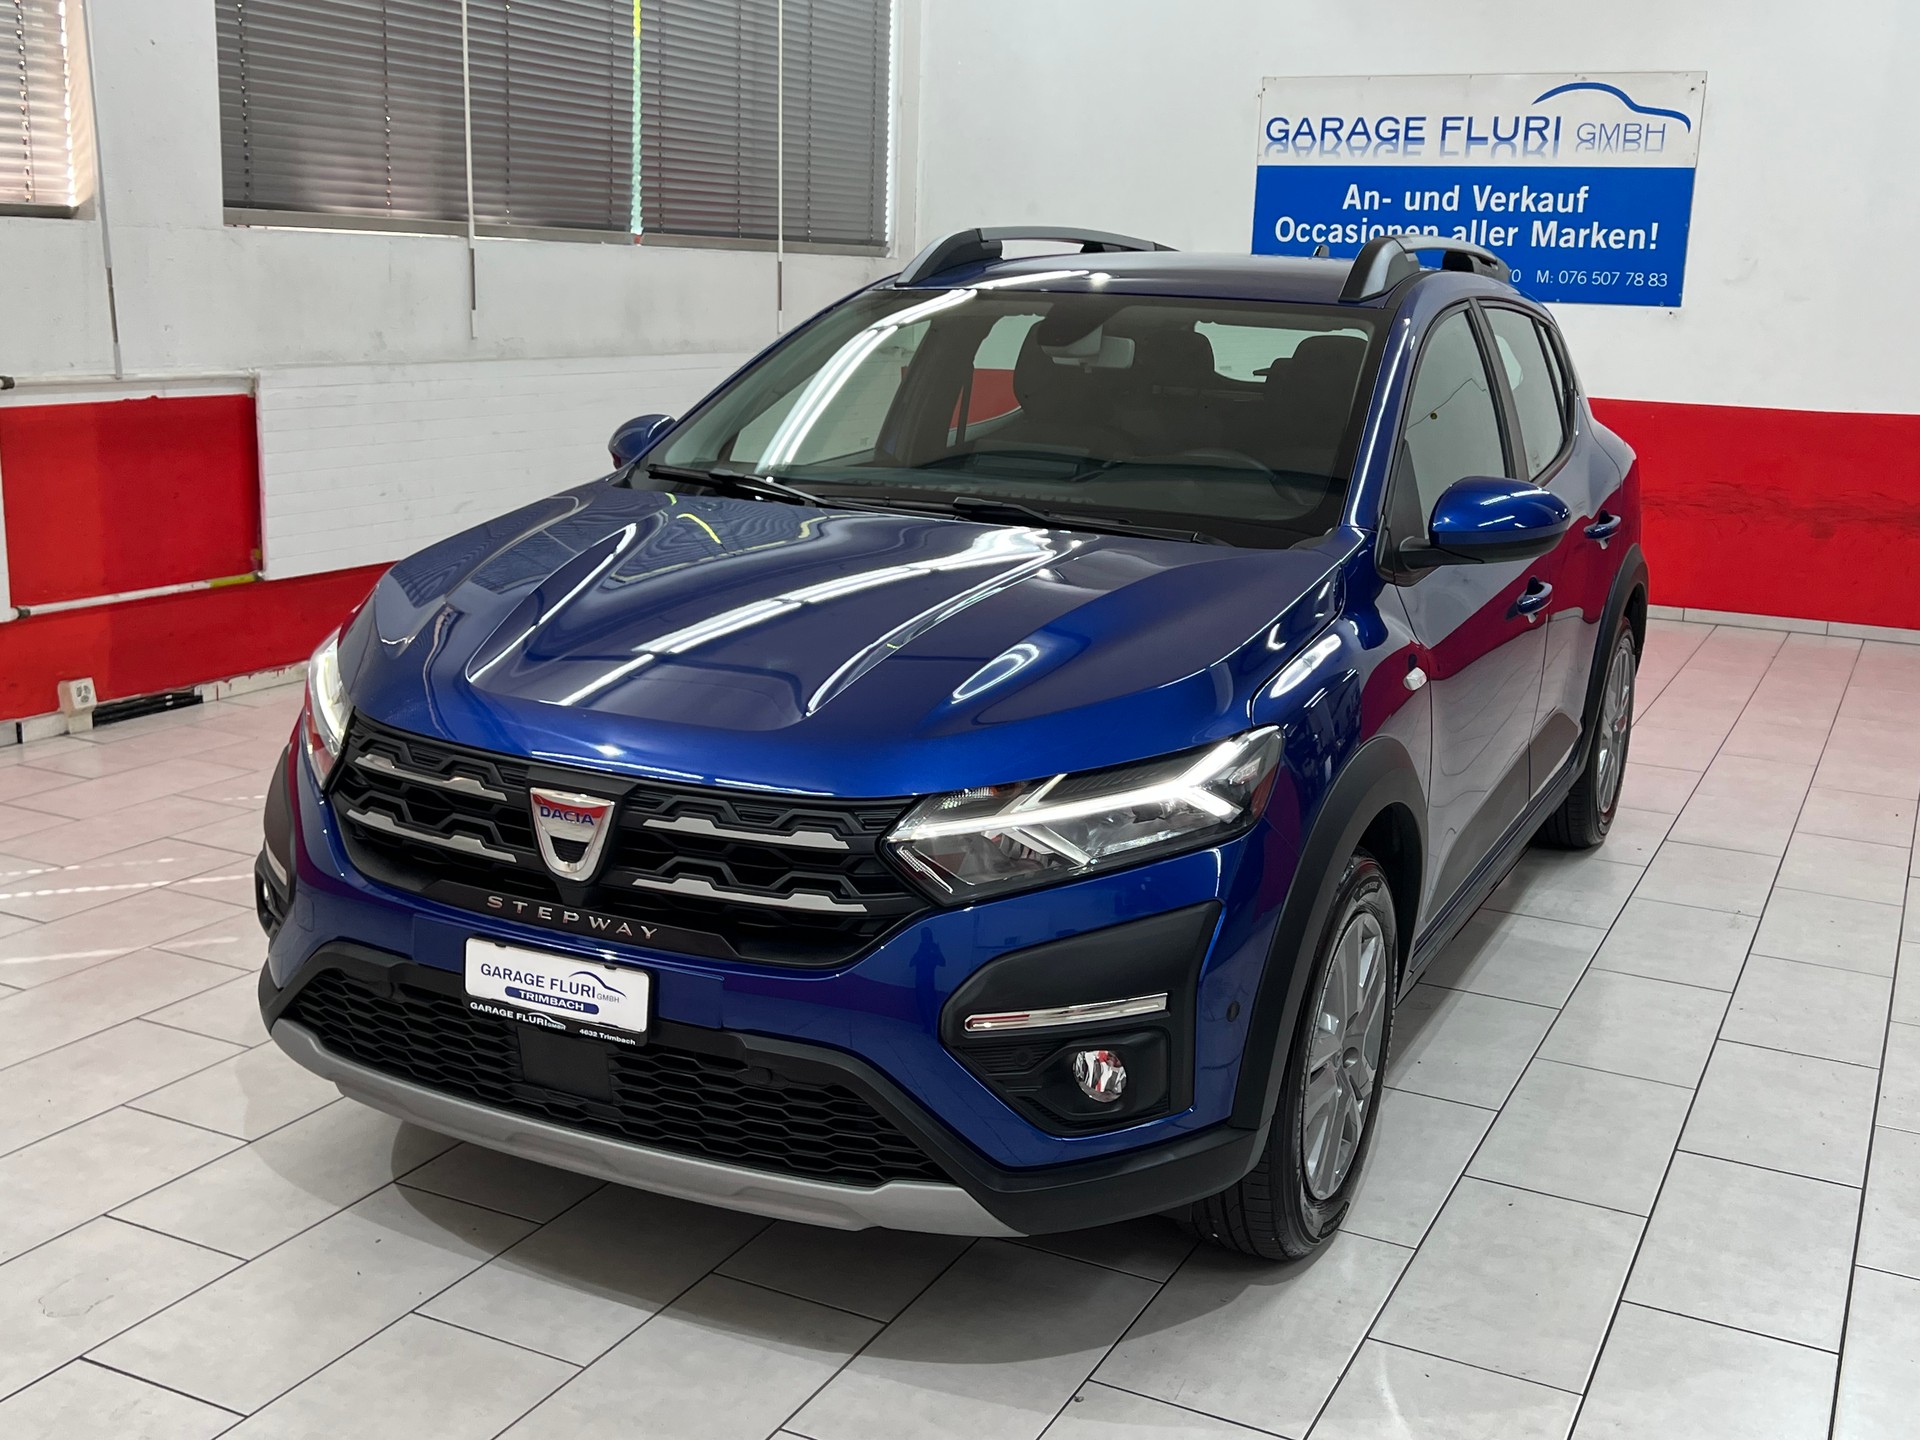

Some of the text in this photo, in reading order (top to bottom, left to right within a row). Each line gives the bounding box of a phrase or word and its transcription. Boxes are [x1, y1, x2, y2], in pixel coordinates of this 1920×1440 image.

[1265, 115, 1667, 143] GARAGE FLURI GMBH
[1342, 184, 1590, 214] An- und Verkauf
[1452, 218, 1519, 247] aller
[1530, 220, 1660, 250] Marken!
[1535, 269, 1554, 284] M:
[1558, 270, 1588, 285] 076
[1591, 271, 1621, 286] 507
[1625, 272, 1645, 287] 78
[1648, 273, 1668, 288] 83
[539, 806, 595, 826] DACIA
[486, 895, 658, 940] STEPWAY
[480, 963, 620, 1004] GARAGE FLURI GMBH
[469, 1001, 514, 1019] GARAGE
[516, 1013, 548, 1027] FLURI
[518, 989, 585, 1012] TRIMBACH
[599, 1032, 636, 1046] Trimbach
